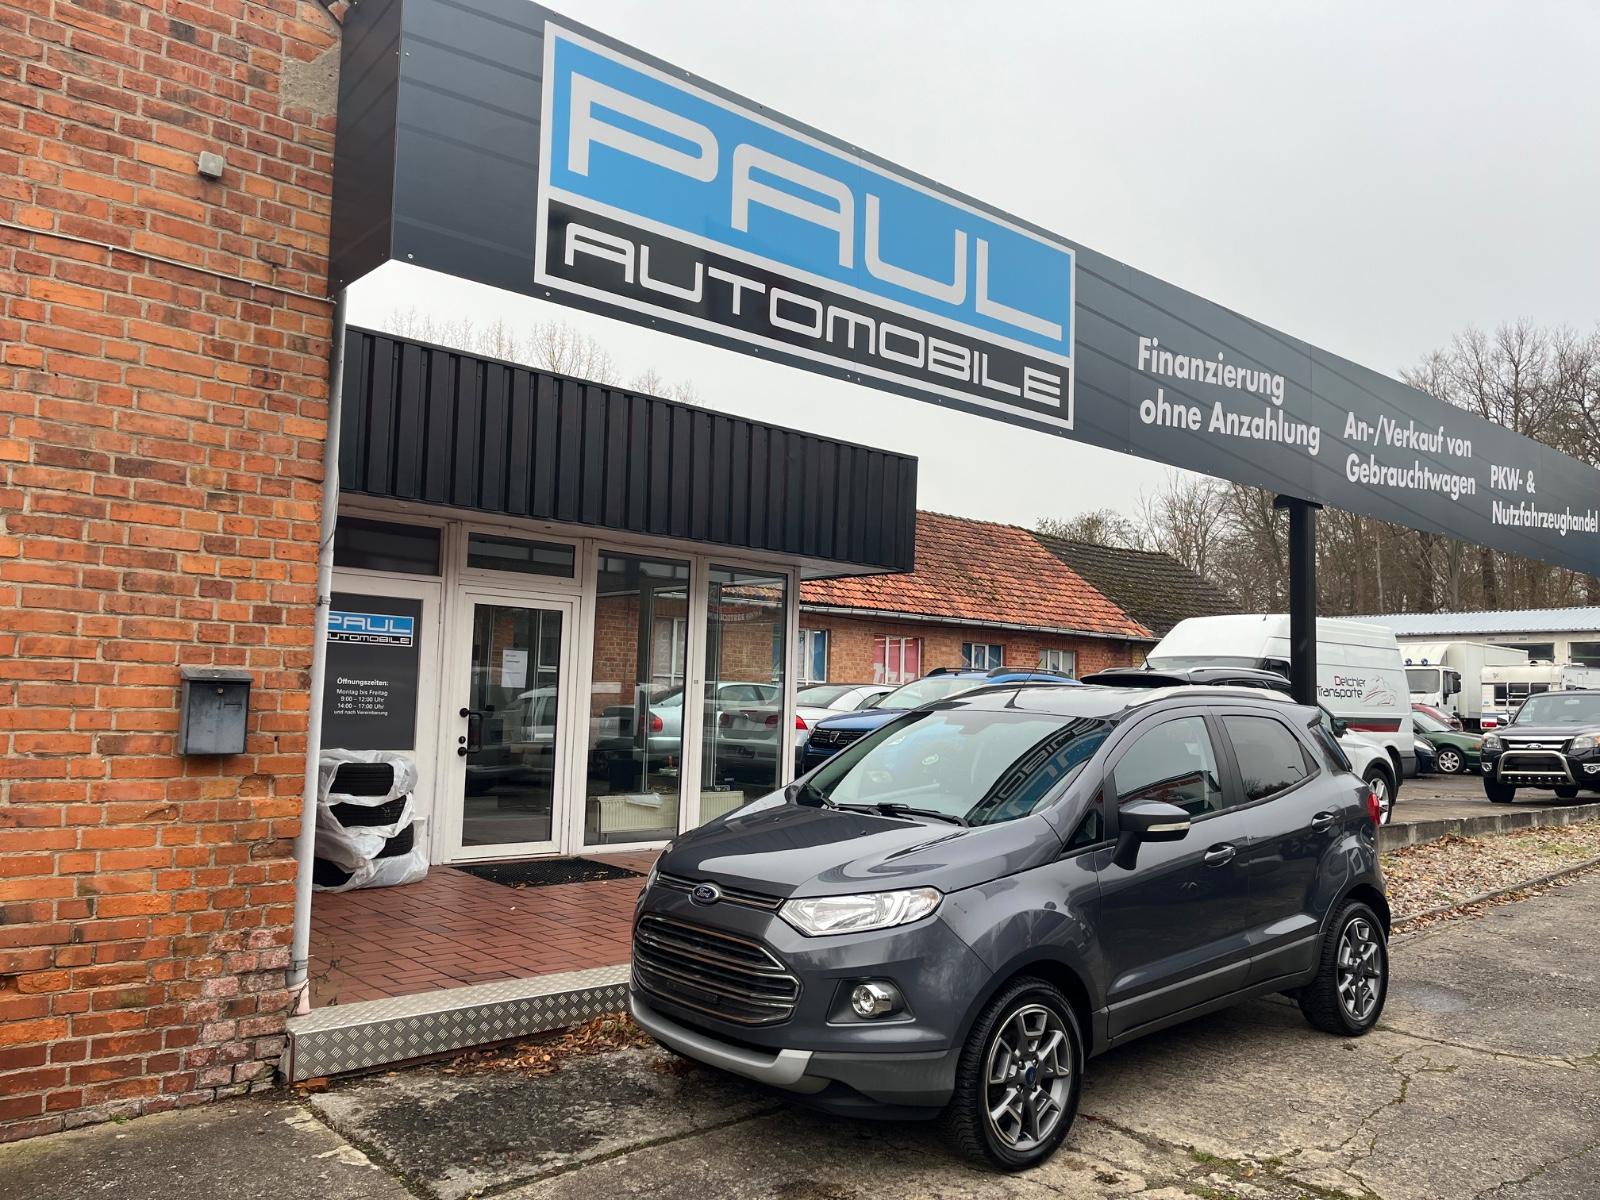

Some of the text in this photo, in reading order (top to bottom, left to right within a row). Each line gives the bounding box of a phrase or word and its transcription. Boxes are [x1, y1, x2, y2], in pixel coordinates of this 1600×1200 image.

[567, 70, 1063, 342] PAUL
[564, 222, 1062, 408] AUTOMOBILE
[1137, 336, 1285, 406] Finanzierung
[1139, 389, 1321, 456] ohne Anzahlung
[1343, 411, 1472, 458] An-/Verkauf von
[1345, 453, 1476, 501] Gebrauchtwagen
[1490, 464, 1536, 494] PKW- &
[1492, 500, 1599, 537] Nutzfahrzeughandel
[328, 614, 411, 633] PAUL
[328, 632, 410, 645] UTOMOBILE
[1316, 685, 1363, 699] Transporte
